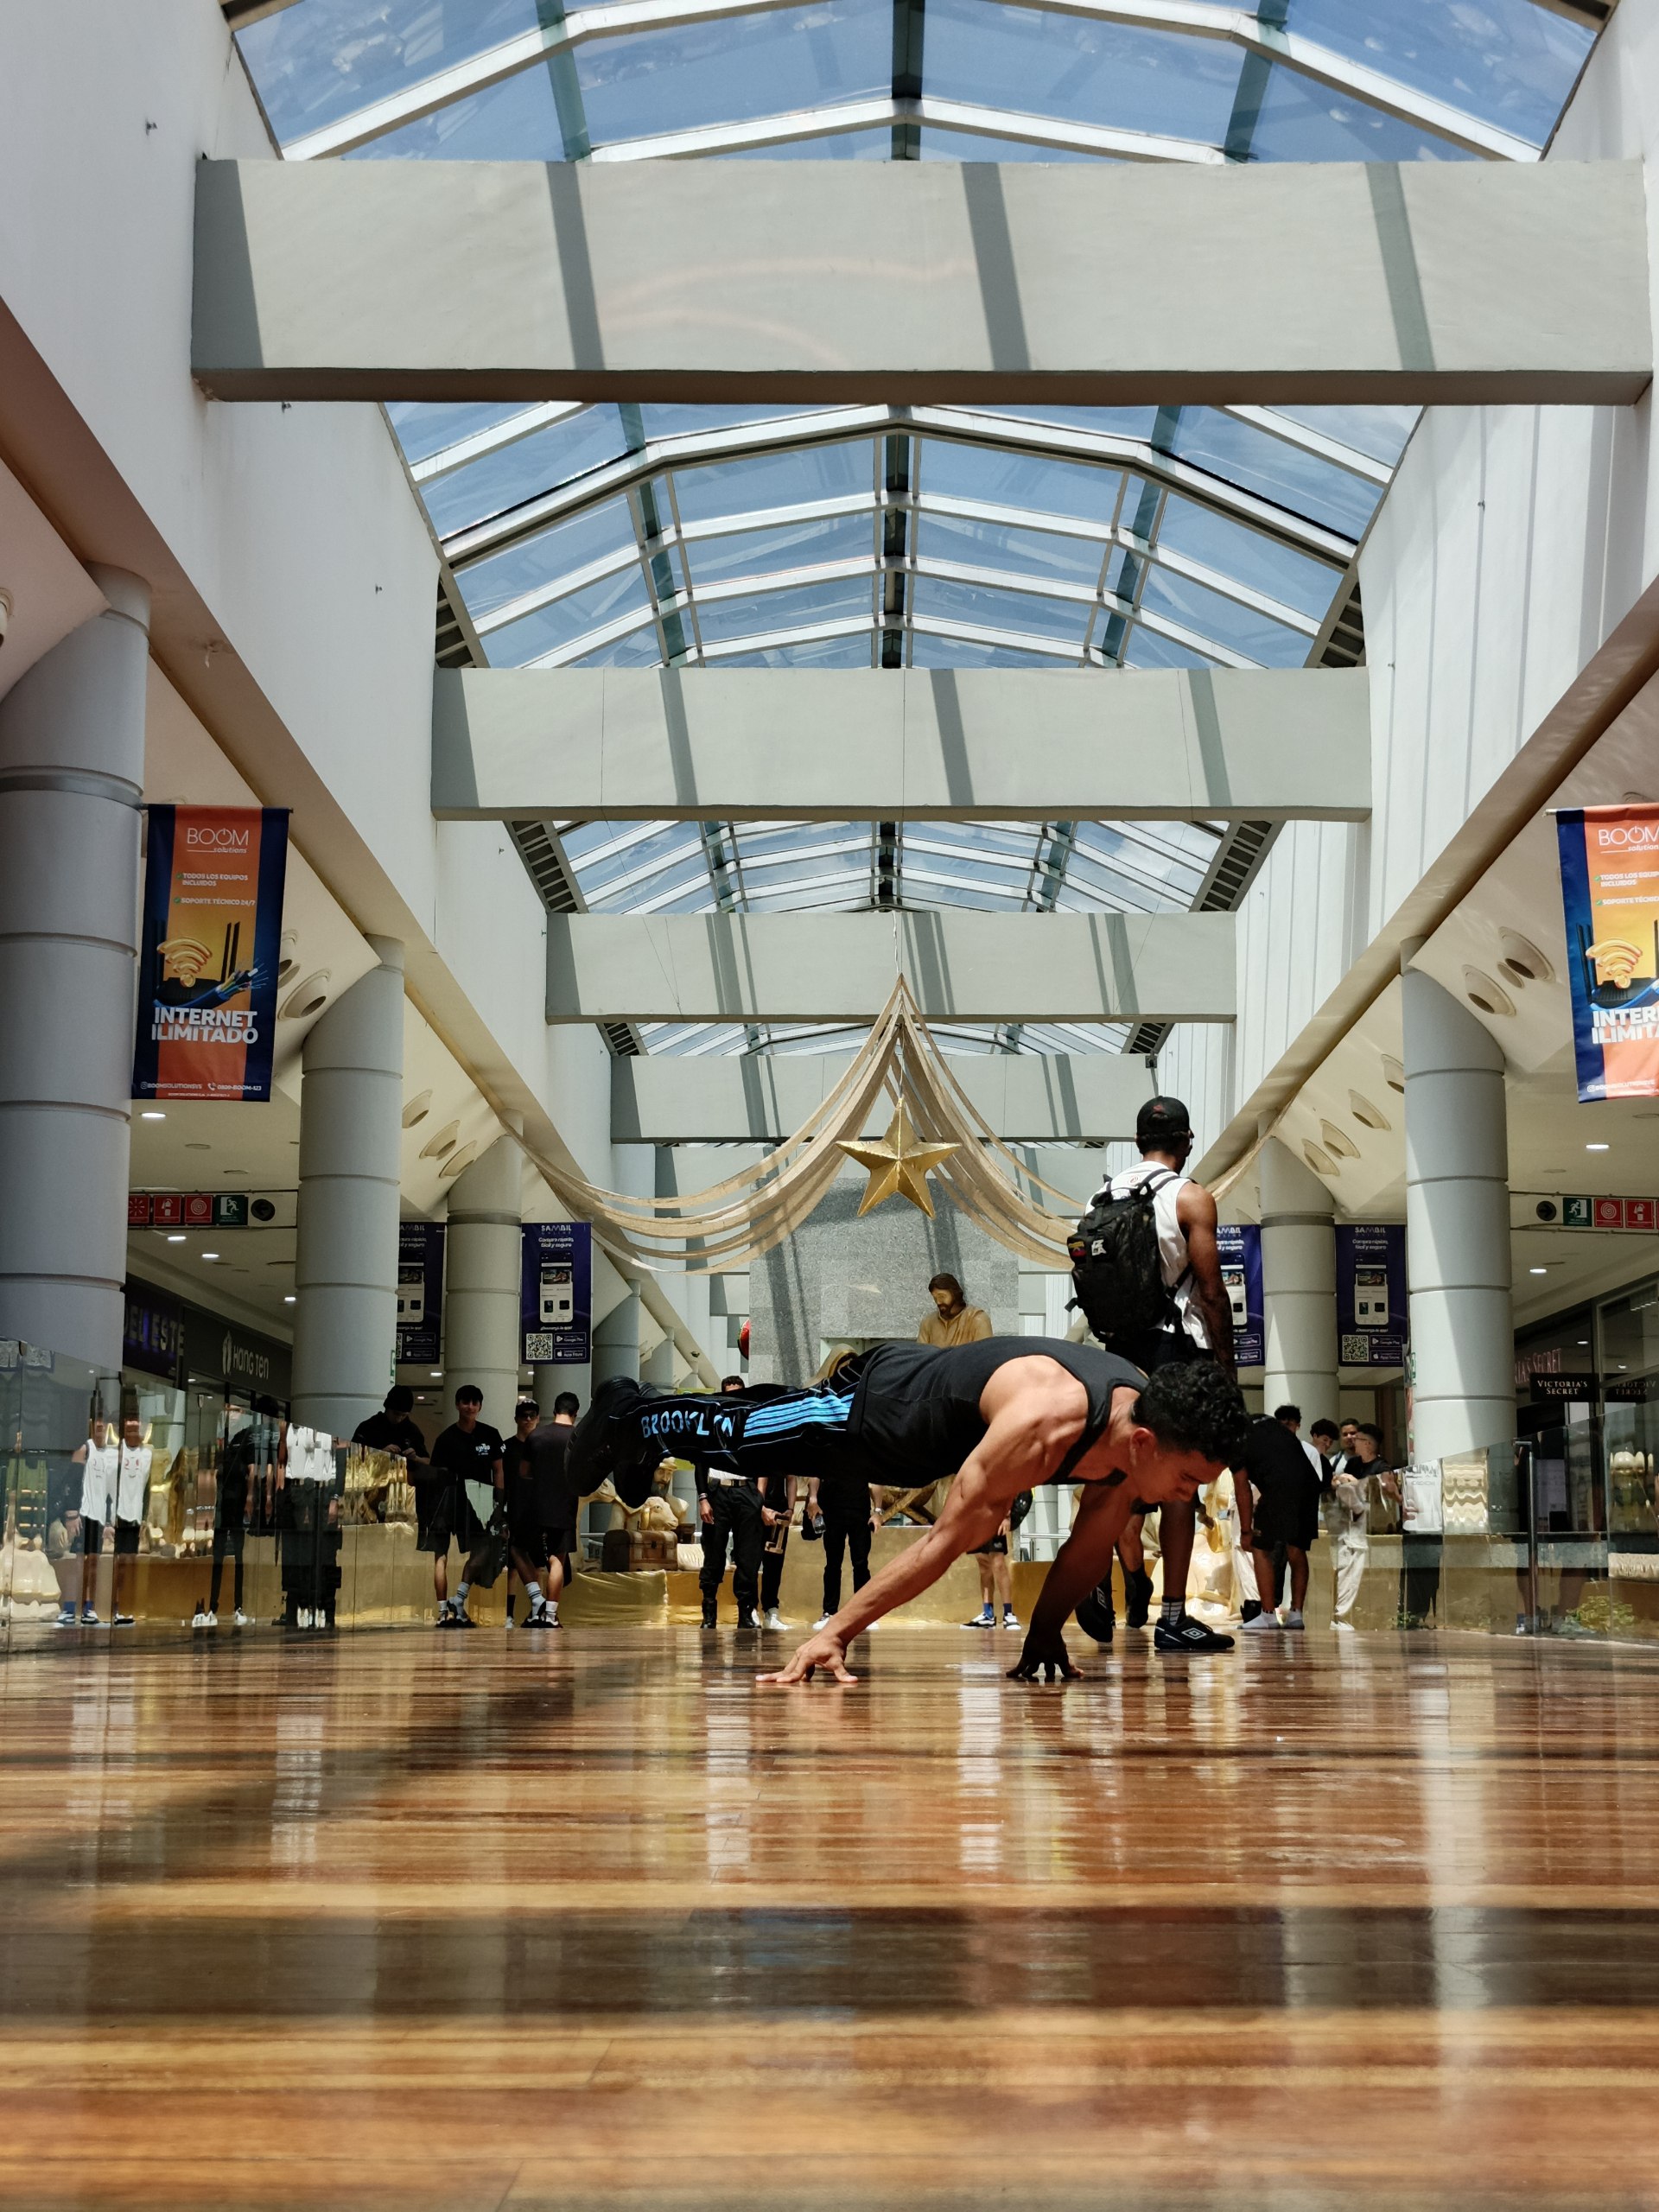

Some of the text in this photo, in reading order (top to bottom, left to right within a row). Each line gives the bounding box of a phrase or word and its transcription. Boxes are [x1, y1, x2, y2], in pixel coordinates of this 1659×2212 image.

[187, 828, 249, 846] BOOM
[1598, 825, 1659, 846] BOOM
[213, 897, 240, 906] TÉCNICO
[1602, 898, 1634, 906] SOPORTE
[155, 1007, 257, 1027] INTERNET
[1592, 1005, 1659, 1027] INTER
[151, 1023, 258, 1045] ILIMITADO
[151, 1313, 186, 1357] ESTE
[640, 1410, 736, 1439] BROOKLN
